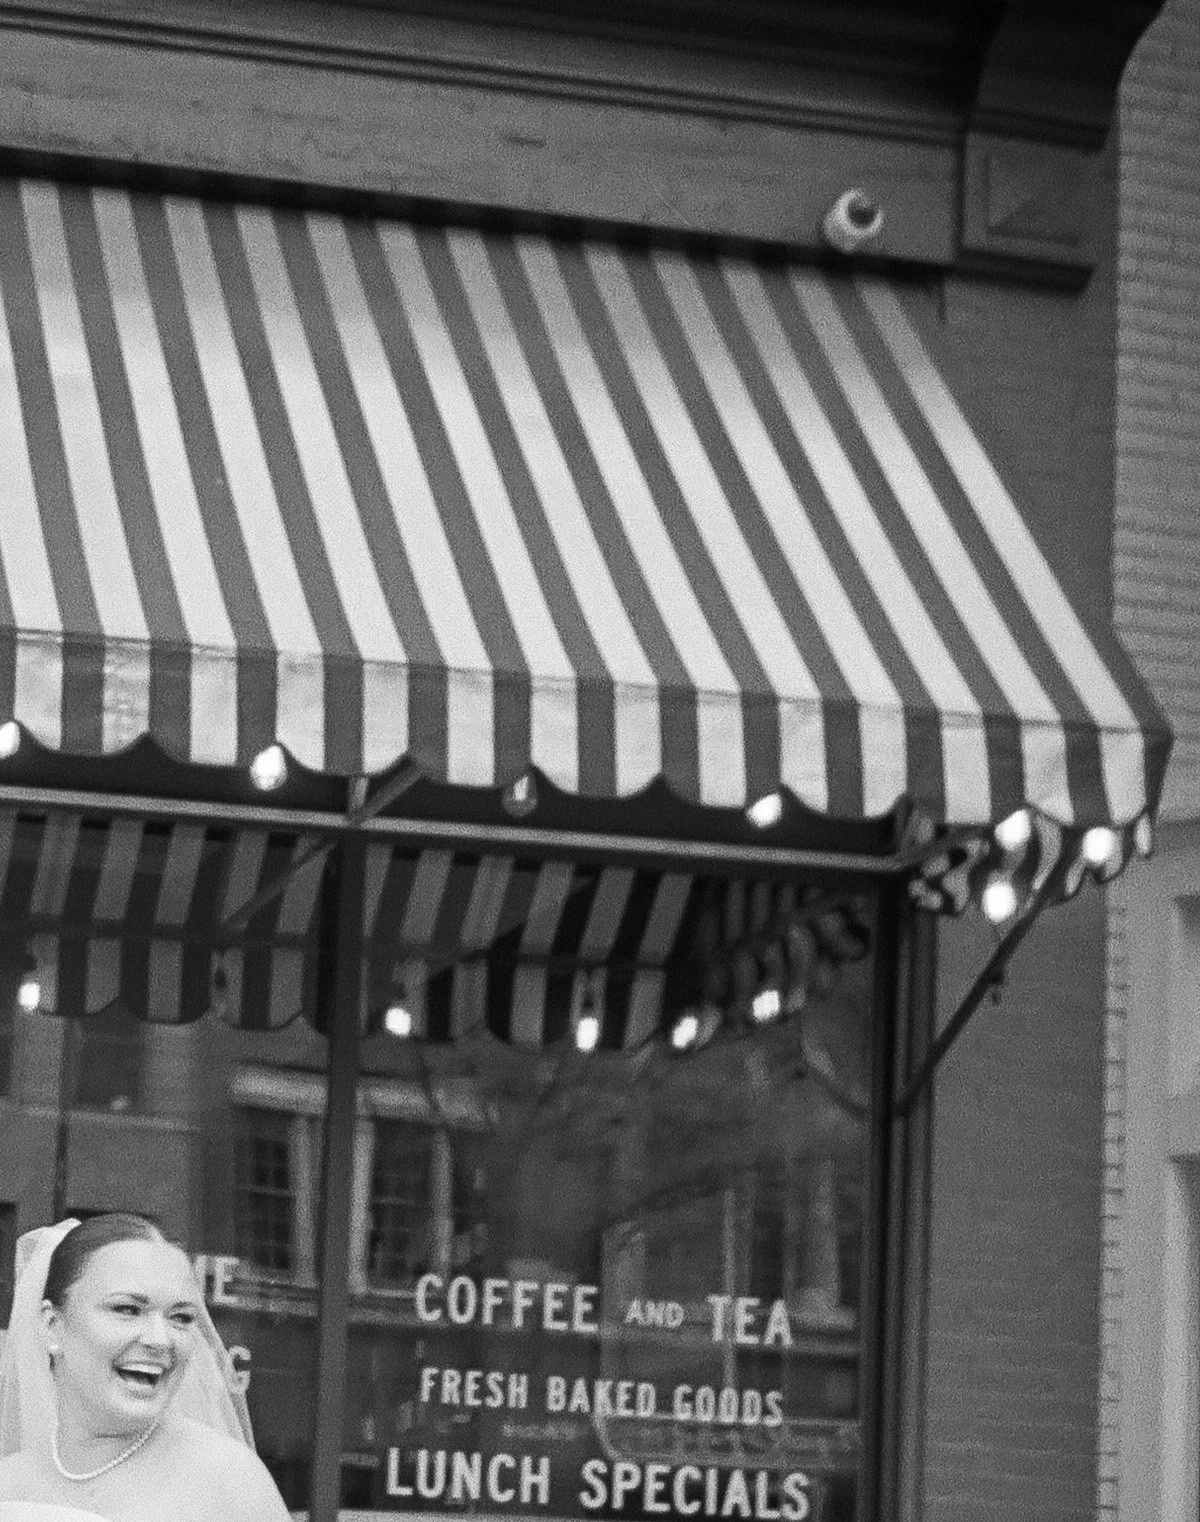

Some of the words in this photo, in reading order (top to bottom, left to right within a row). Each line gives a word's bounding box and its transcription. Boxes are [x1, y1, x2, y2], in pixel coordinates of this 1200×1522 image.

[414, 1273, 599, 1334] COFFEE
[625, 1299, 684, 1328] AND
[708, 1295, 793, 1347] TEA
[419, 1367, 529, 1409] FRESH
[547, 1376, 657, 1418] BAKED
[673, 1384, 784, 1427] GOODS
[386, 1447, 550, 1505] LUNCH
[579, 1459, 812, 1521] SPECIALS
